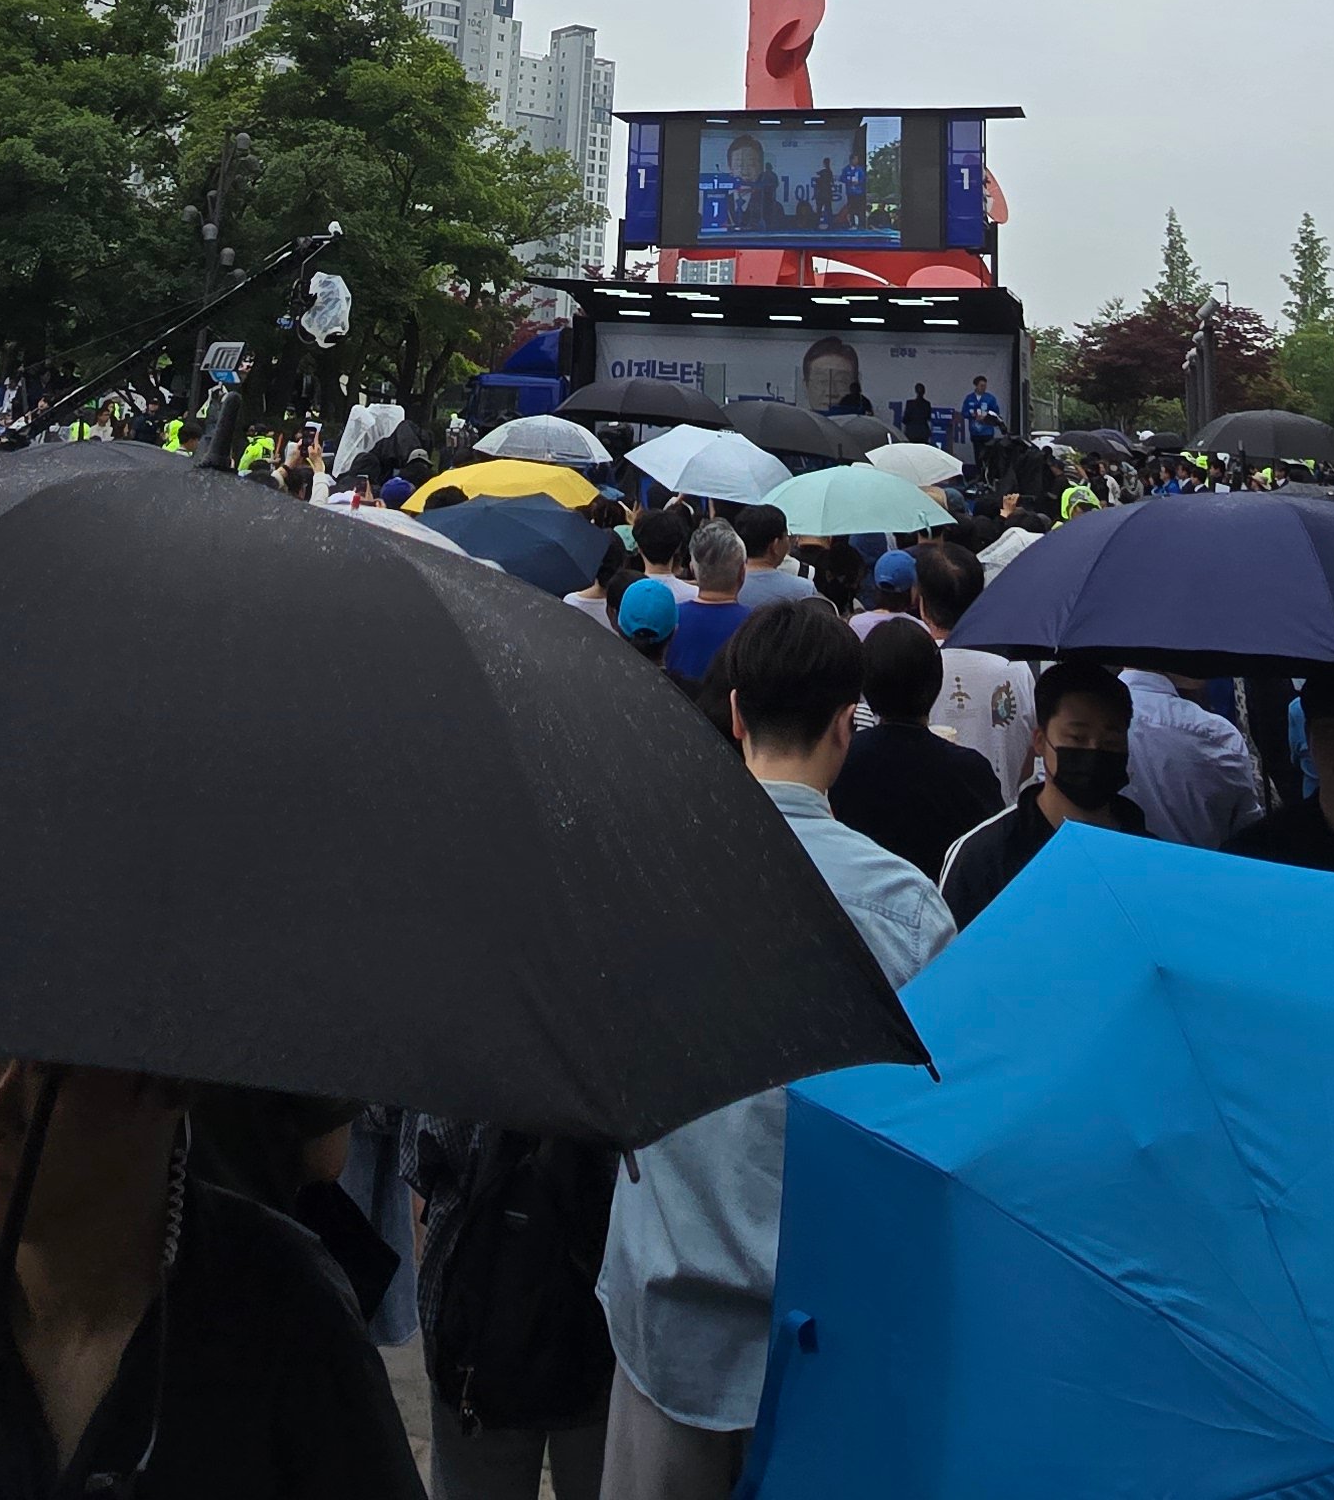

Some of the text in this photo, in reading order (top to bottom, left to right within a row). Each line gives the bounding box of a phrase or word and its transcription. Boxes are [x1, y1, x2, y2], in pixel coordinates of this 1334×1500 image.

[637, 168, 646, 189] 1
[781, 175, 790, 203] 1
[960, 168, 970, 190] 1
